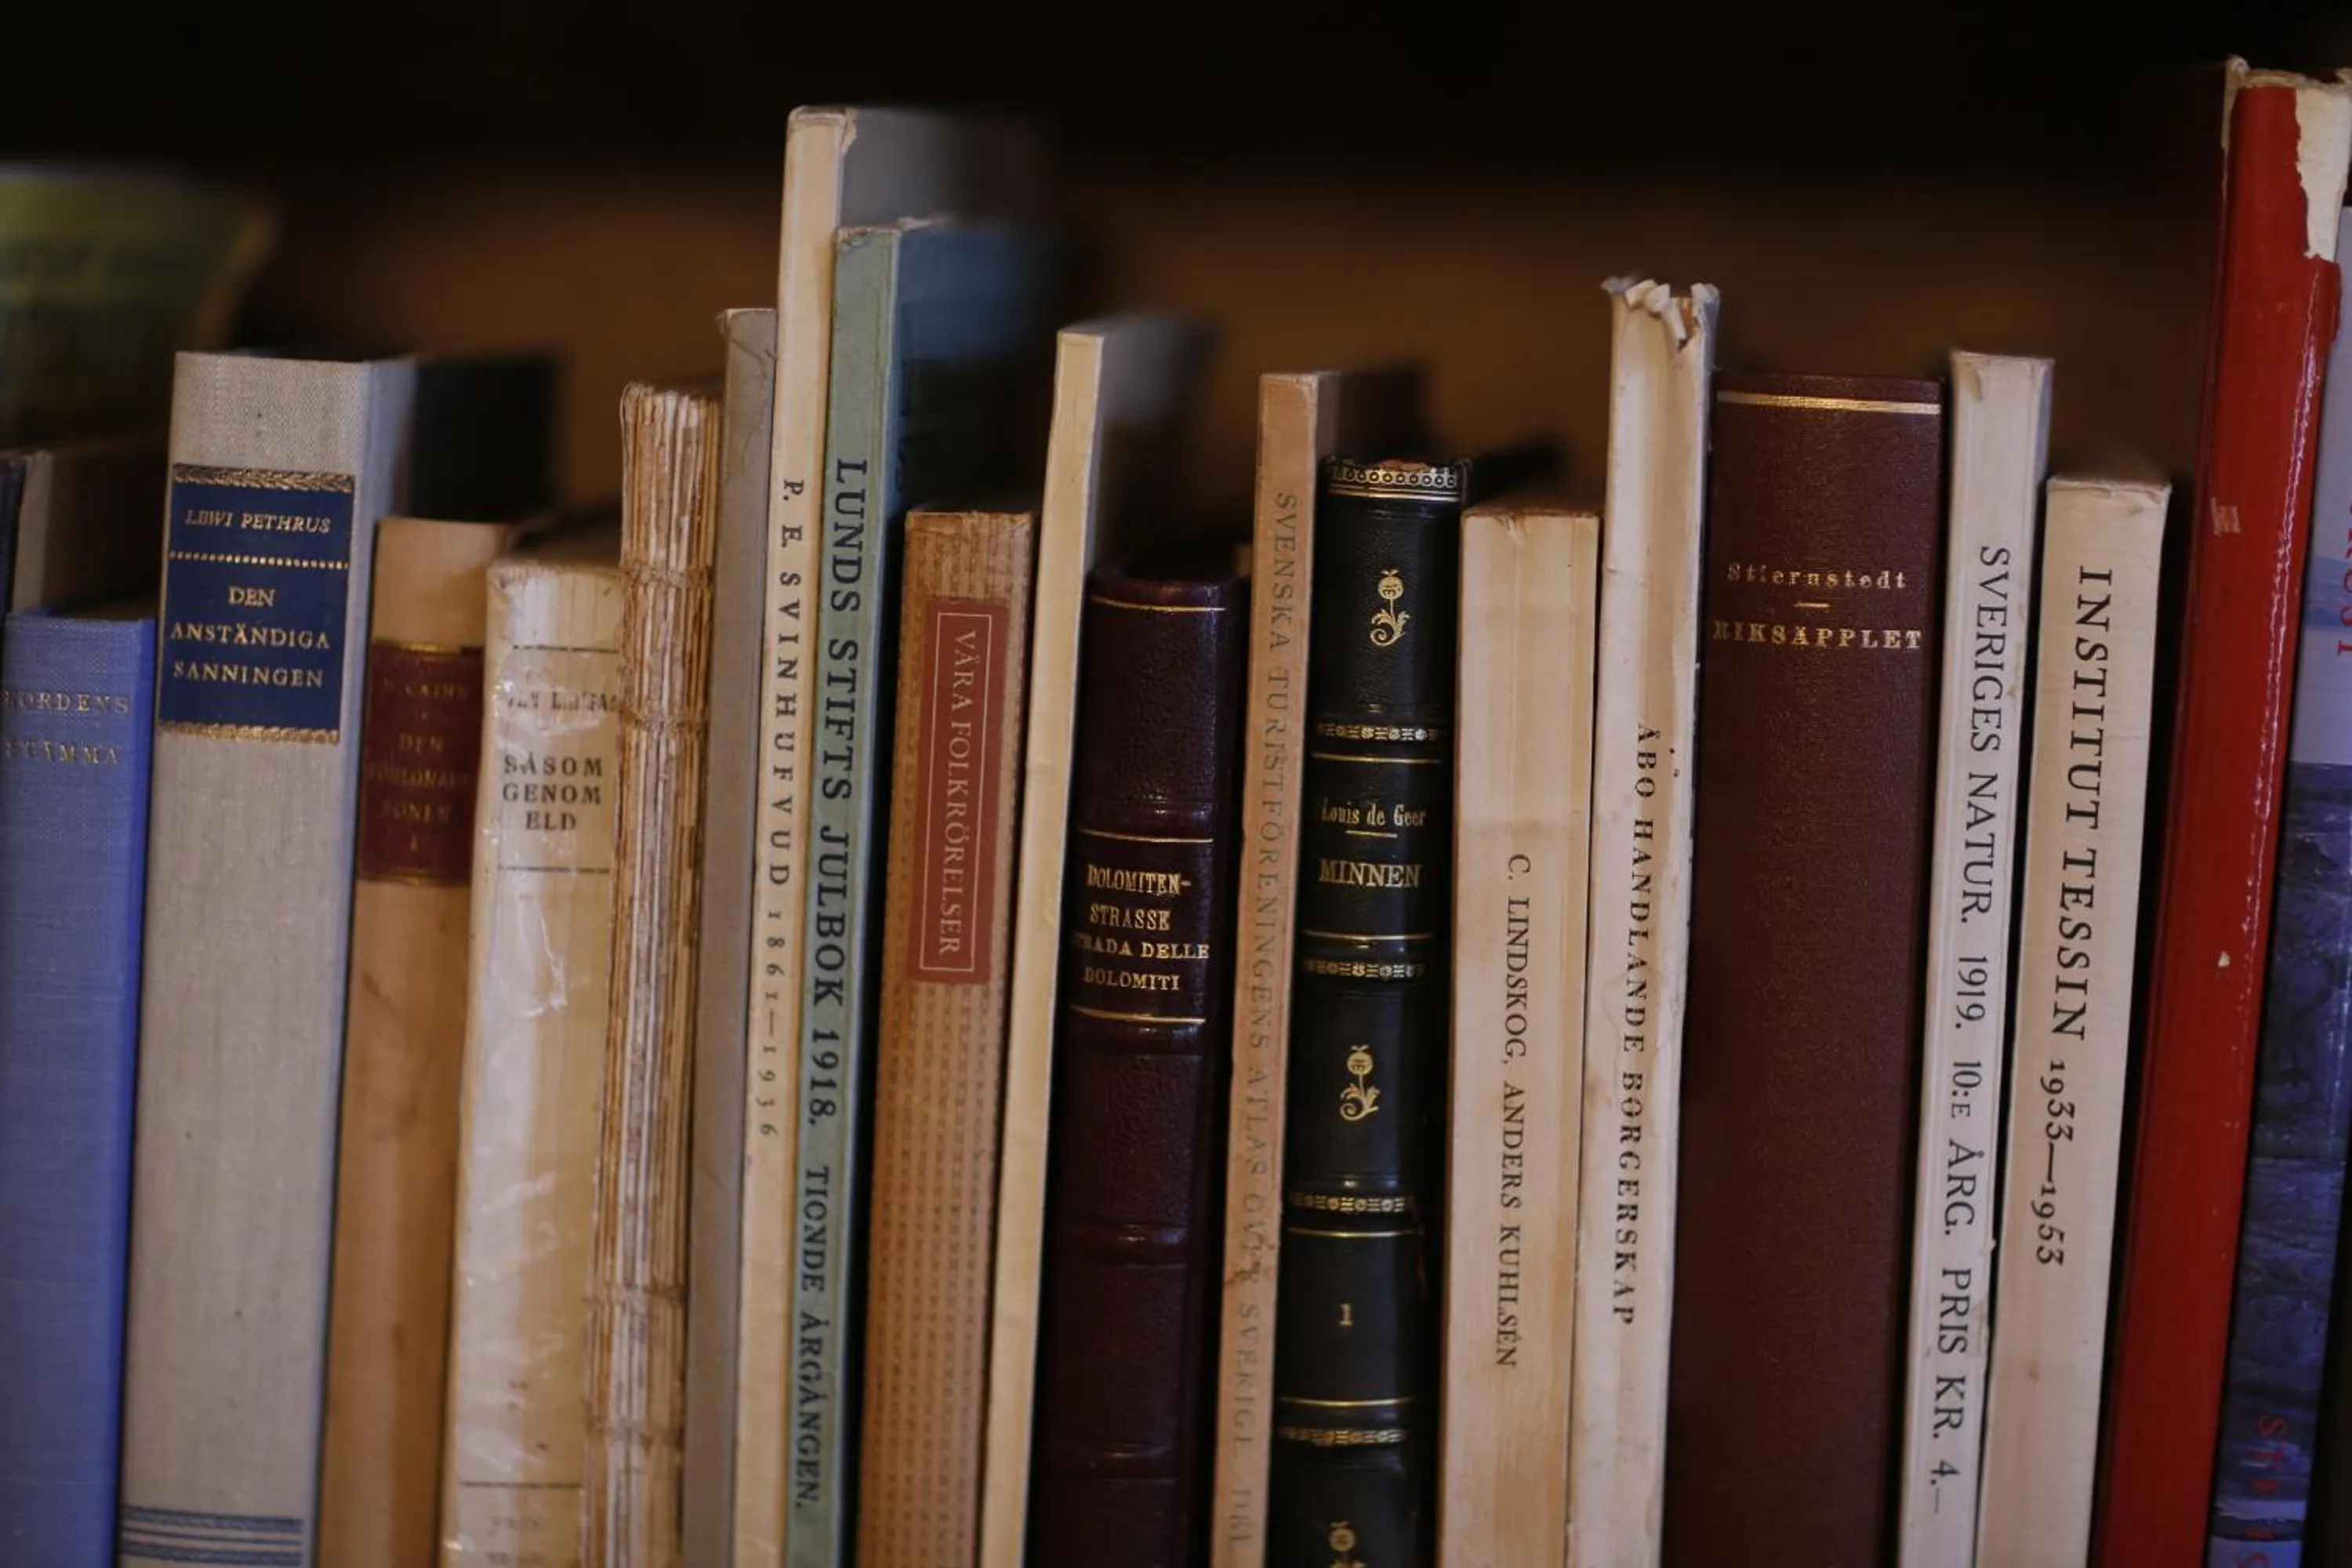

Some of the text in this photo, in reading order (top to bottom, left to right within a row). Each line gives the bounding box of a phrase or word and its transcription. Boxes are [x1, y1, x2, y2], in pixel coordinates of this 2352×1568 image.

[782, 479, 804, 501] P.
[241, 513, 331, 533] PETHRUS
[782, 524, 803, 549] E.
[1270, 492, 1297, 649] SVENSKA
[1726, 562, 1907, 590] Stiernstedt
[229, 586, 274, 608] DEN
[170, 621, 331, 649] ANSTÄNDIGA
[1713, 619, 1922, 651] RIKSÄPPLET
[1970, 546, 2011, 753] SVERIGES
[172, 660, 324, 687] SANNINGEN
[2066, 564, 2113, 829] INSTITUT
[770, 572, 801, 885] SVINHUFVUD
[503, 750, 603, 778] SÅSOM
[503, 782, 602, 804] GENOM
[526, 811, 577, 831] ELD
[1321, 797, 1427, 827] Louis de Geer
[938, 720, 971, 955] FOLKRÖRELSER
[1958, 771, 1998, 923] NATUR.
[1087, 864, 1192, 896] DOLOMITEN-
[1319, 858, 1423, 889] MINNEN
[1507, 853, 1530, 882] C.
[1089, 902, 1171, 931] STRASSE
[1141, 941, 1210, 959] DELLE
[2052, 849, 2098, 1040] TESSIN
[795, 458, 868, 1509] LUNDS STIFTS JULBOK 1918. TIONDE ÅRGÅNGEN.
[1083, 966, 1181, 991] DOLOMITI
[1955, 955, 1987, 1029] 1919.
[1613, 723, 1661, 1325] ÅBO HANDLANDE BORGERSKAP
[1246, 1069, 1269, 1174] ATLAS
[1501, 1080, 1524, 1209] ANDERS
[1944, 1138, 1985, 1235] ÅRG.
[1495, 1225, 1522, 1368] KUHLSÉN
[1936, 1267, 1972, 1355] PRIS
[1931, 1375, 1965, 1439] KR.
